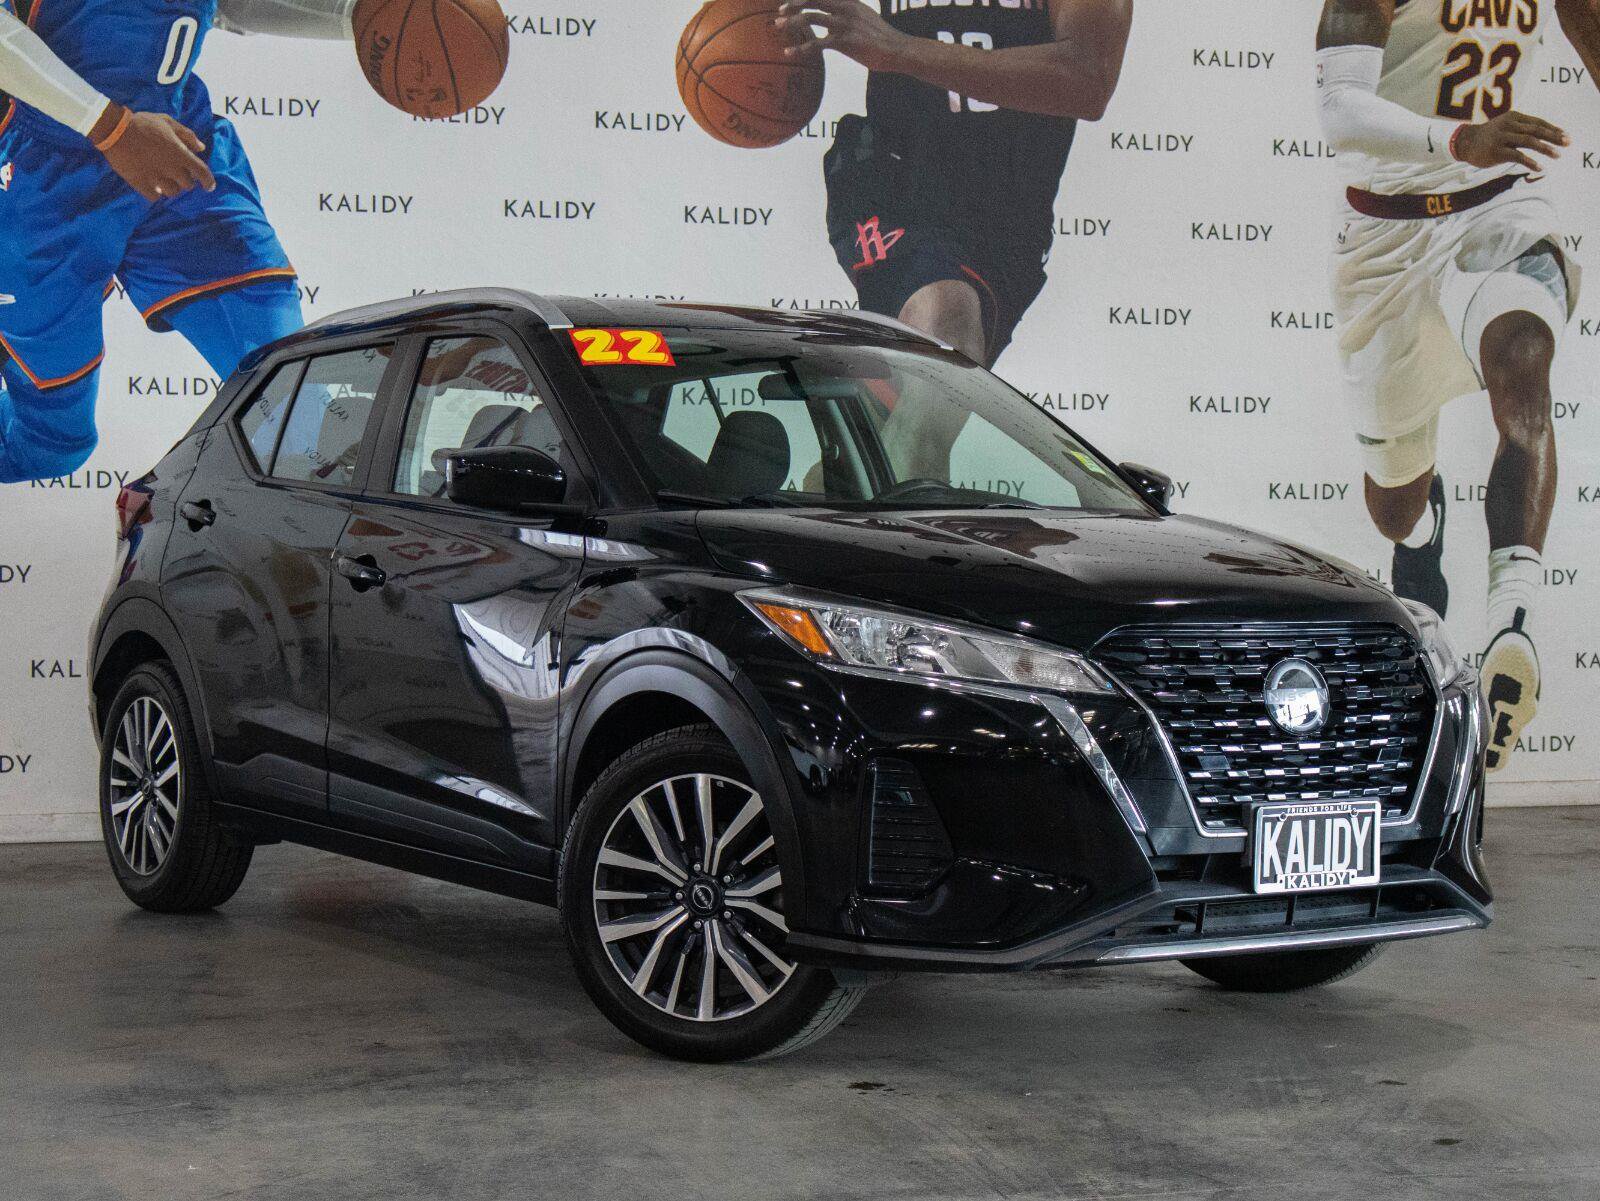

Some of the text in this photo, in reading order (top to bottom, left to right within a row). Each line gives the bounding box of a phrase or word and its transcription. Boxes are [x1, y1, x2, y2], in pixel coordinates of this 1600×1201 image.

[506, 15, 594, 37] KALIDY
[157, 16, 197, 85] 0
[1194, 49, 1274, 69] KALIDY
[1436, 39, 1521, 120] 23
[1540, 66, 1585, 84] IDY
[225, 96, 320, 118] KALIDY
[413, 106, 505, 125] LIDY
[595, 111, 686, 132] KALIDY
[1112, 133, 1193, 152] KALIDY
[320, 194, 413, 213] KALIDY
[505, 199, 595, 219] KALIDY
[1426, 196, 1453, 214] CLE
[685, 206, 773, 225] KALIDY
[1052, 218, 1111, 236] LIDY
[1192, 223, 1272, 241] KALIDY
[1110, 307, 1191, 325] KALIDY
[1271, 311, 1334, 329] KALID
[573, 328, 668, 363] 22
[128, 376, 222, 396] KALIDY
[681, 387, 767, 406] KALID
[1190, 396, 1270, 413] KALIDY
[1270, 483, 1348, 500] KALIDY
[1513, 735, 1576, 752] ALIDY
[1287, 806, 1317, 814] FRIENDS
[1337, 804, 1352, 812] LIFE
[1263, 817, 1372, 877] KALIDY
[1287, 871, 1347, 889] KALIDY
